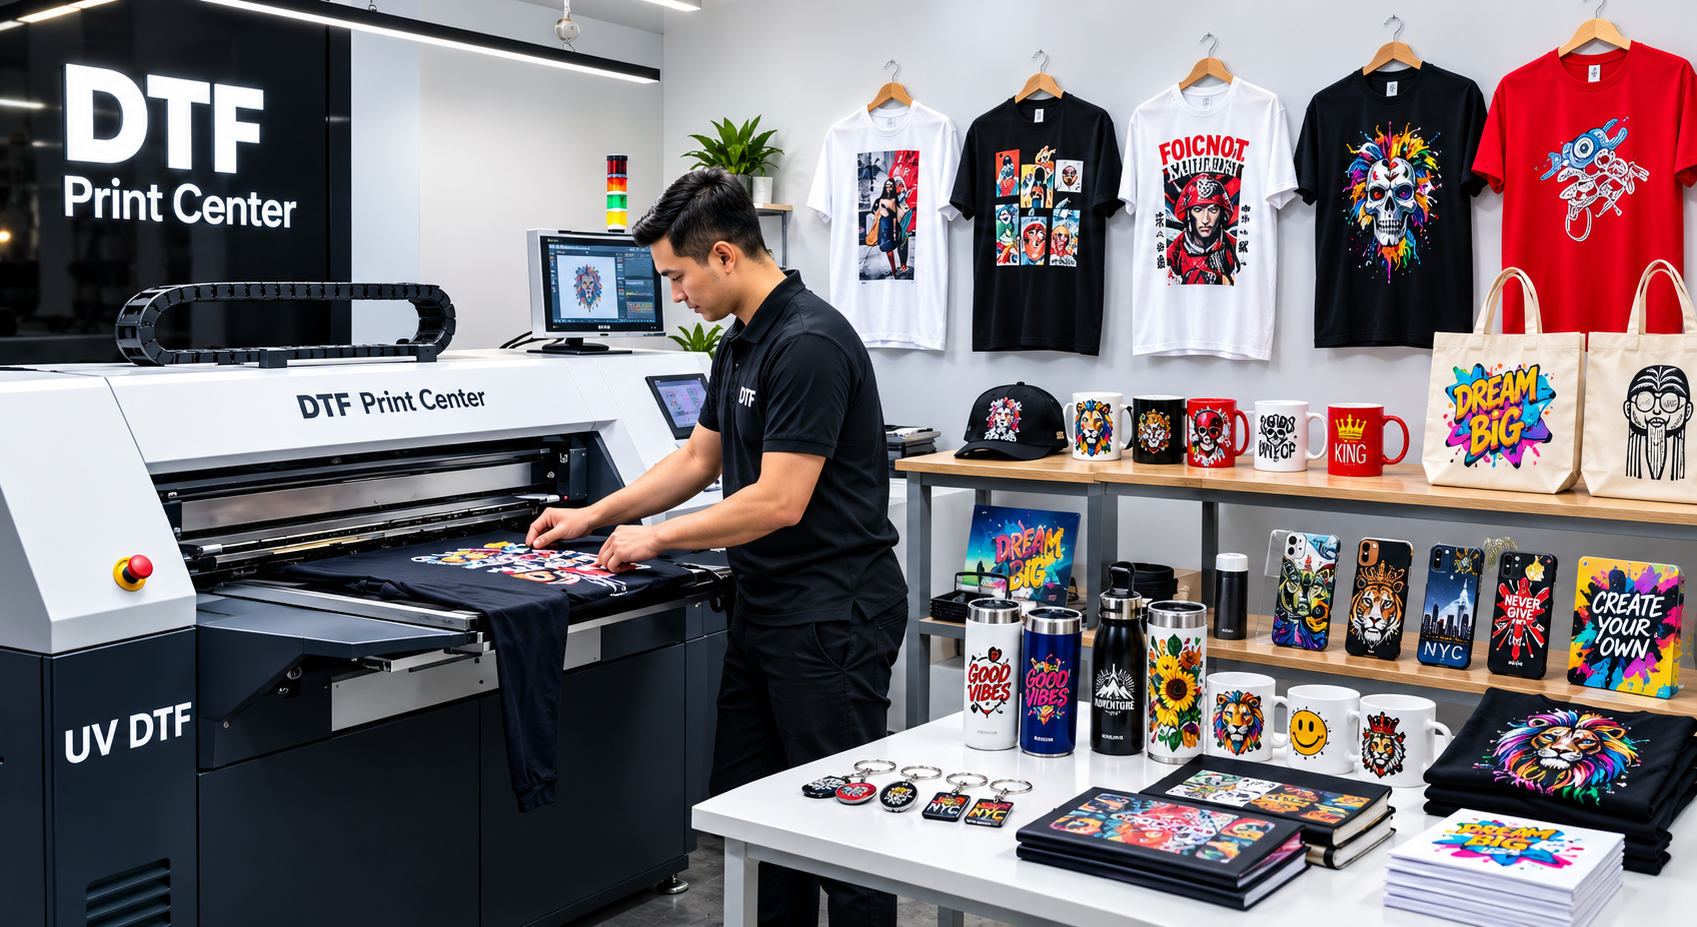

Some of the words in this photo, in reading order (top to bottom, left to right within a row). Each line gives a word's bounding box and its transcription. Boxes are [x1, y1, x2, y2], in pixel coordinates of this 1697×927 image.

[63, 63, 264, 174] DTF
[64, 175, 163, 222] Print
[173, 183, 297, 228] Center
[296, 392, 351, 419] DTF
[359, 391, 417, 414] Print
[419, 389, 485, 411] Center
[739, 386, 756, 407] DTF
[1453, 364, 1541, 423] DREAM
[1334, 442, 1366, 464] KING
[995, 525, 1065, 564] DREAM
[1504, 594, 1541, 610] NEVER
[1592, 590, 1665, 618] CREATE
[1507, 606, 1534, 620] GIVE
[1595, 615, 1653, 644] YOUR
[1424, 641, 1463, 660] NYC
[1600, 636, 1651, 660] OWN
[968, 663, 1011, 684] GOOD
[1025, 668, 1069, 689] GOOD
[967, 681, 1011, 702] VIBES
[1025, 686, 1069, 708] VIBES
[65, 718, 119, 764] UV
[130, 701, 192, 749] DTF
[926, 802, 961, 815] NYC
[967, 807, 1007, 821] NYC
[1455, 823, 1559, 840] DREAM
[1464, 834, 1533, 851] BIG
